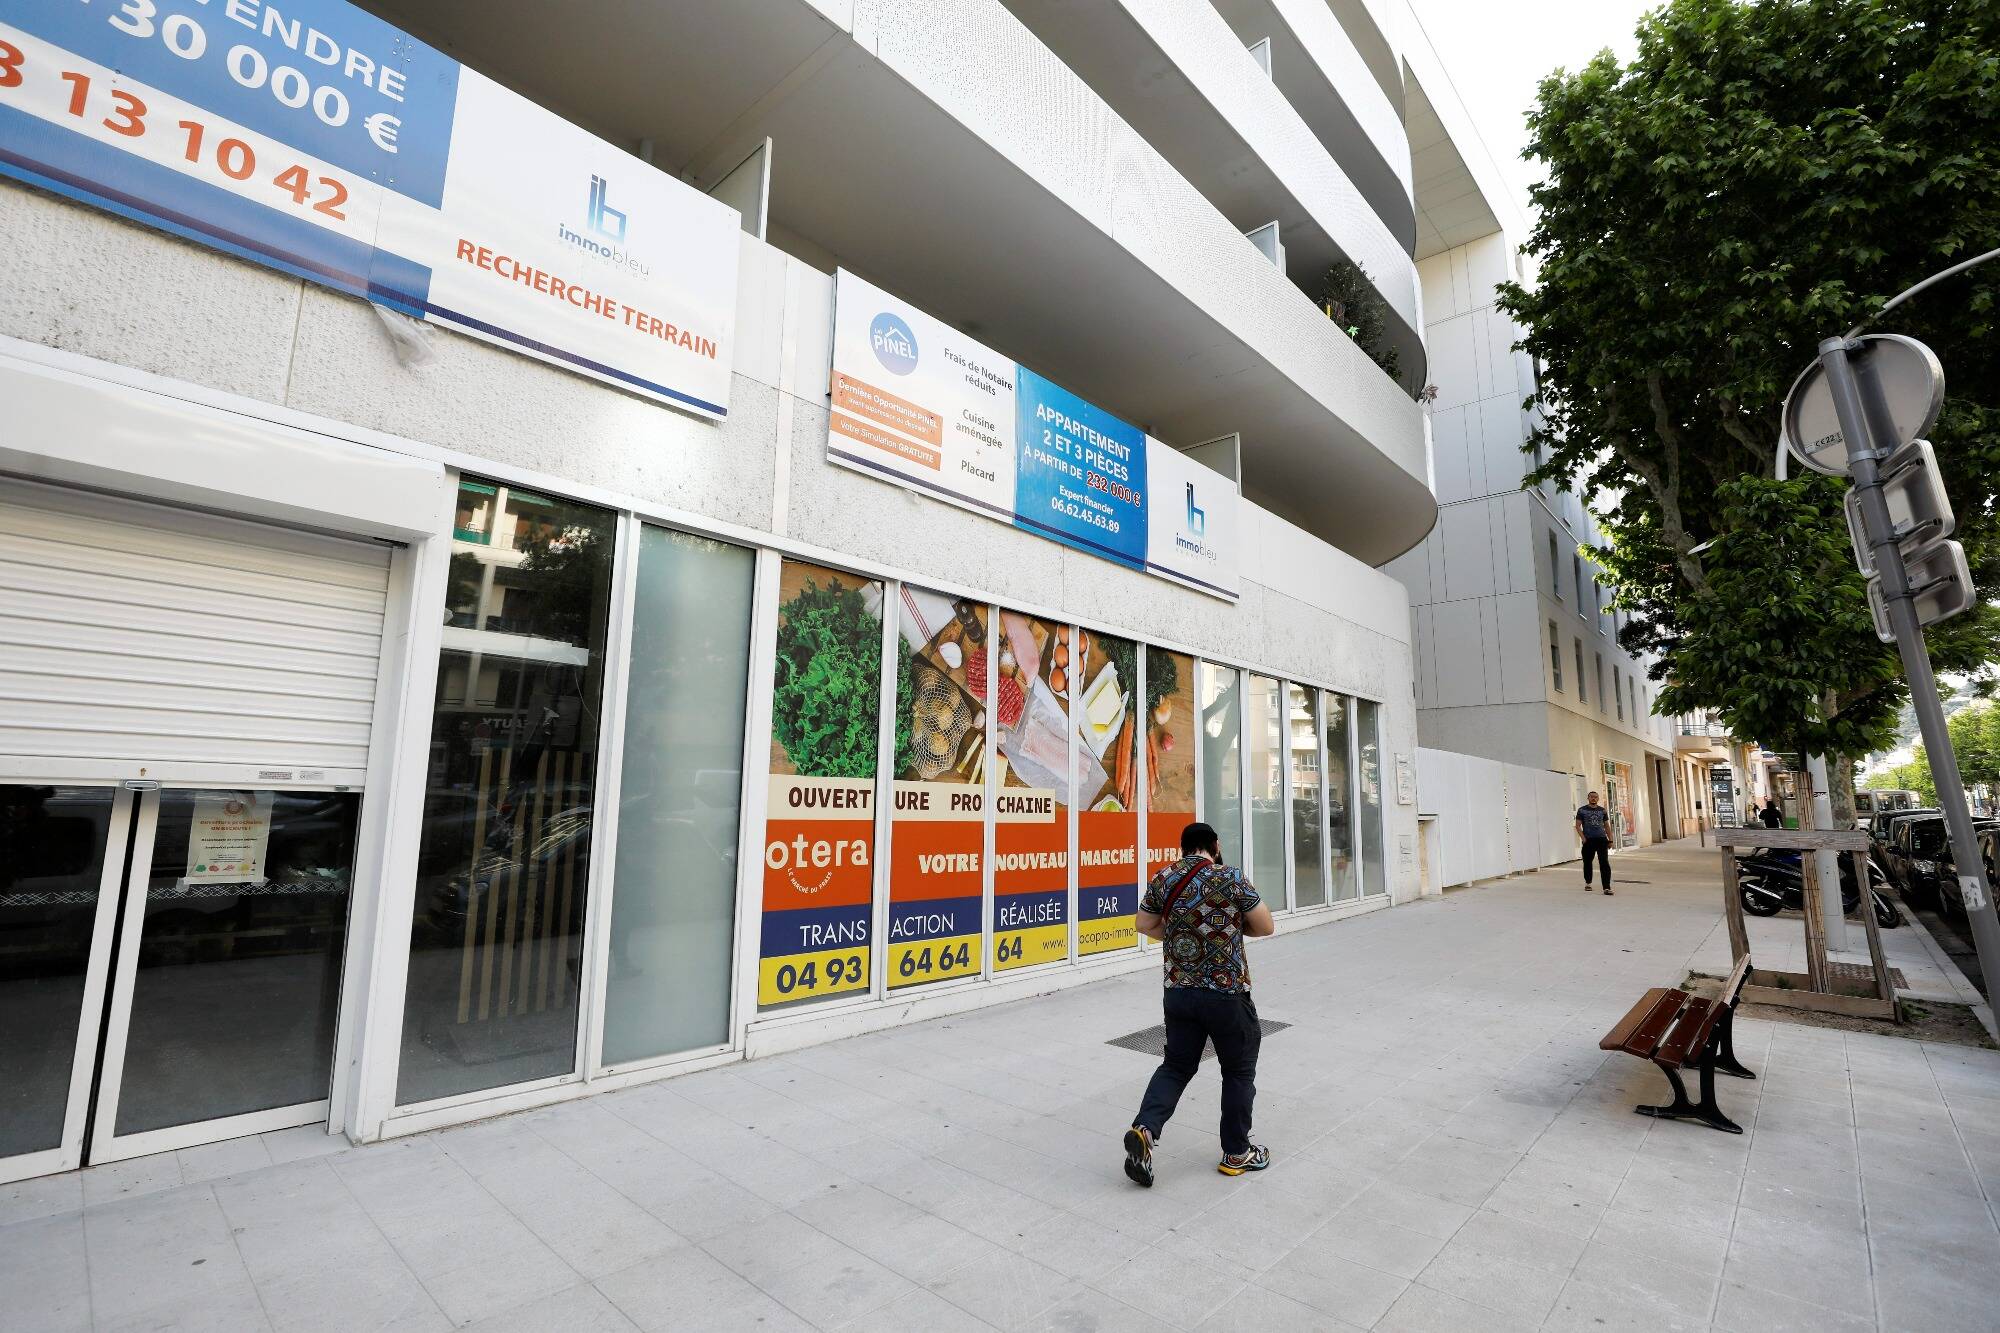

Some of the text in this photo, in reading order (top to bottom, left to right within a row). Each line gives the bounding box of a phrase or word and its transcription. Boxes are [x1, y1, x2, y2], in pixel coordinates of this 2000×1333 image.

[195, 0, 407, 103] ENDRE
[85, 0, 402, 153] 30 000 €
[61, 71, 147, 138] 13
[178, 120, 256, 180] 10
[272, 164, 348, 222] 42
[559, 222, 650, 276] immobleu
[456, 238, 617, 320] RECHERCHE
[621, 305, 717, 360] TERRAIN
[874, 335, 916, 360] PINEL
[944, 348, 1013, 391] Frais de Notaire
[965, 374, 996, 396] réduits
[839, 379, 872, 400] Dernière
[873, 395, 917, 419] Opportunité
[956, 422, 1003, 449] aménagée
[962, 409, 995, 432] Cuisine
[1036, 403, 1131, 462] APPARTEMENT
[840, 419, 934, 463] Votre Simulation GRATUITE
[1043, 429, 1129, 481] 2 ET 3 PIÈCES
[961, 460, 995, 482] Placard
[1024, 442, 1141, 507] À PARTIR DE 232 000 €
[1051, 497, 1120, 534] 06.62.45.63.89
[1059, 485, 1114, 516] Expert financier
[1176, 532, 1217, 561] immobleu
[766, 833, 869, 870] otera
[918, 844, 1183, 874] VOTRE NOUVEAU MARCHÉ DU FRA
[787, 867, 794, 876] LE
[790, 877, 809, 894] MARCHÉ
[819, 871, 833, 889] FRAIS
[1000, 897, 1061, 927] RÉALISÉE
[1097, 896, 1118, 915] PAR
[776, 961, 817, 994] 04
[825, 955, 862, 986] 93
[899, 947, 932, 977] 64
[939, 942, 970, 972] 64
[997, 935, 1023, 963] 64
[1079, 926, 1136, 946] ocopro-immo-
